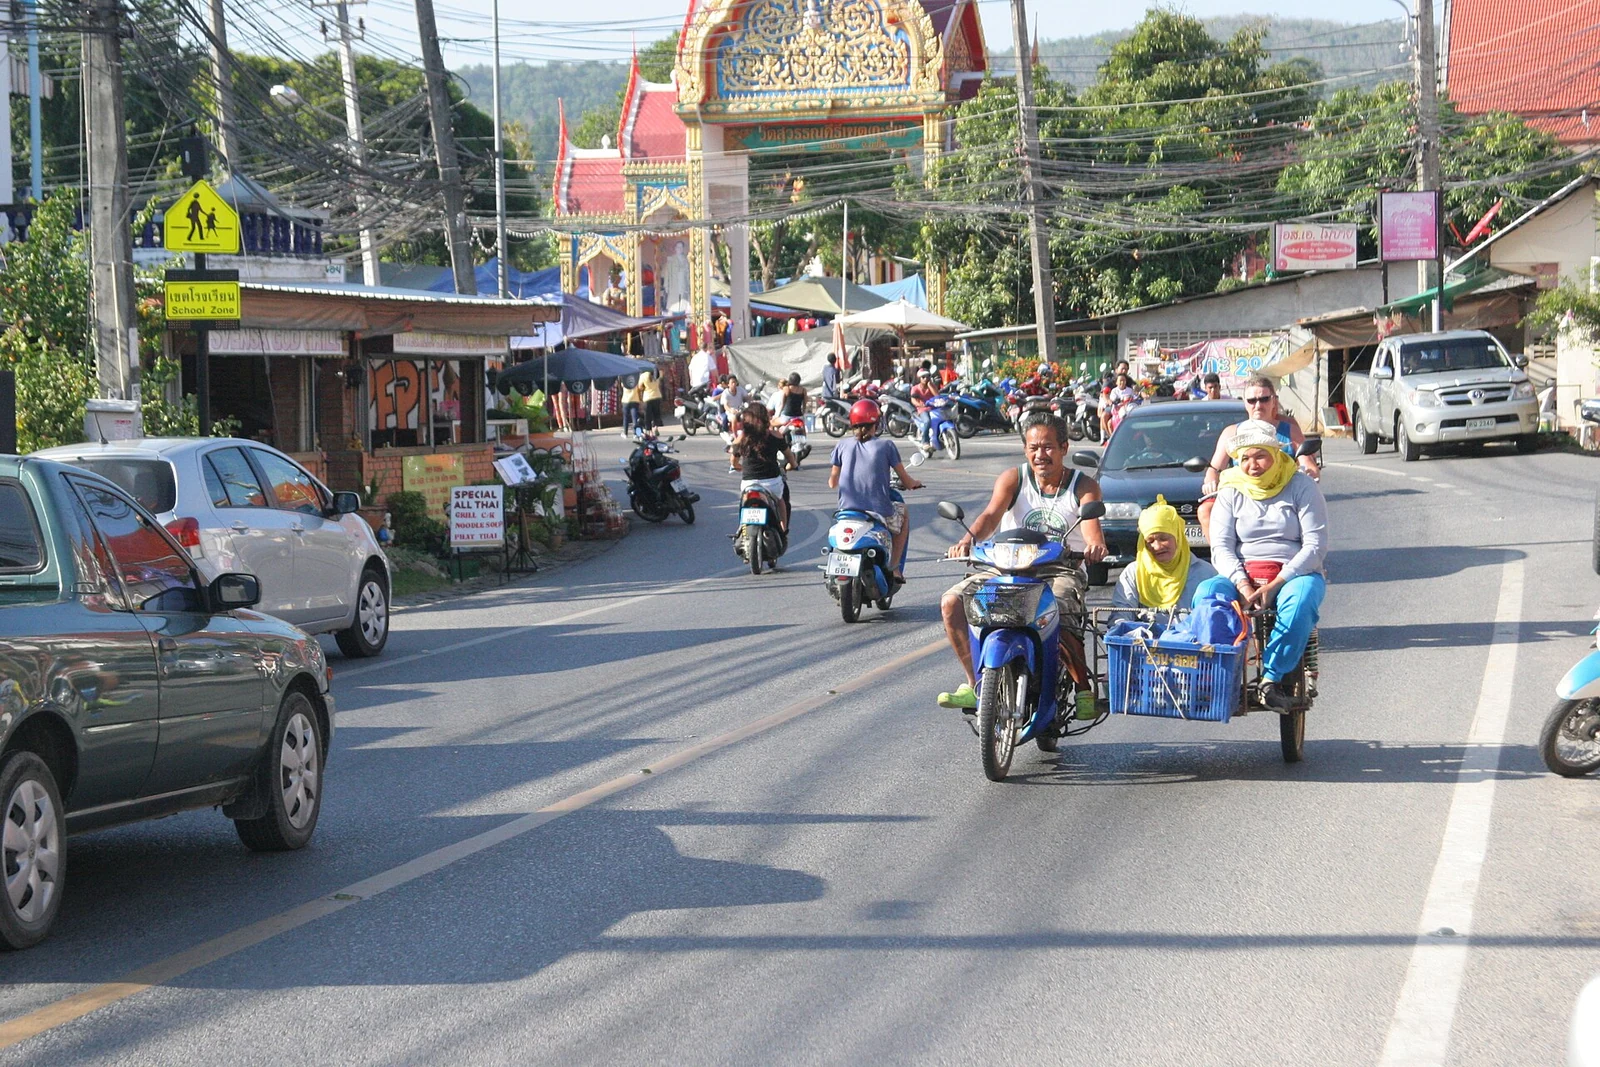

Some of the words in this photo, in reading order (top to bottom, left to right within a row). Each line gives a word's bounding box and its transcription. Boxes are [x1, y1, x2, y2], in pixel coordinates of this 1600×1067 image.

[169, 286, 235, 303] เขตโรงเรียน
[172, 306, 205, 314] School
[210, 306, 235, 314] Zone
[454, 490, 497, 499] SPECIAL
[454, 501, 472, 509] ALL
[475, 500, 499, 509] THAI
[455, 511, 477, 519] GRILL
[1184, 527, 1206, 538] 468
[834, 567, 851, 575] 661
